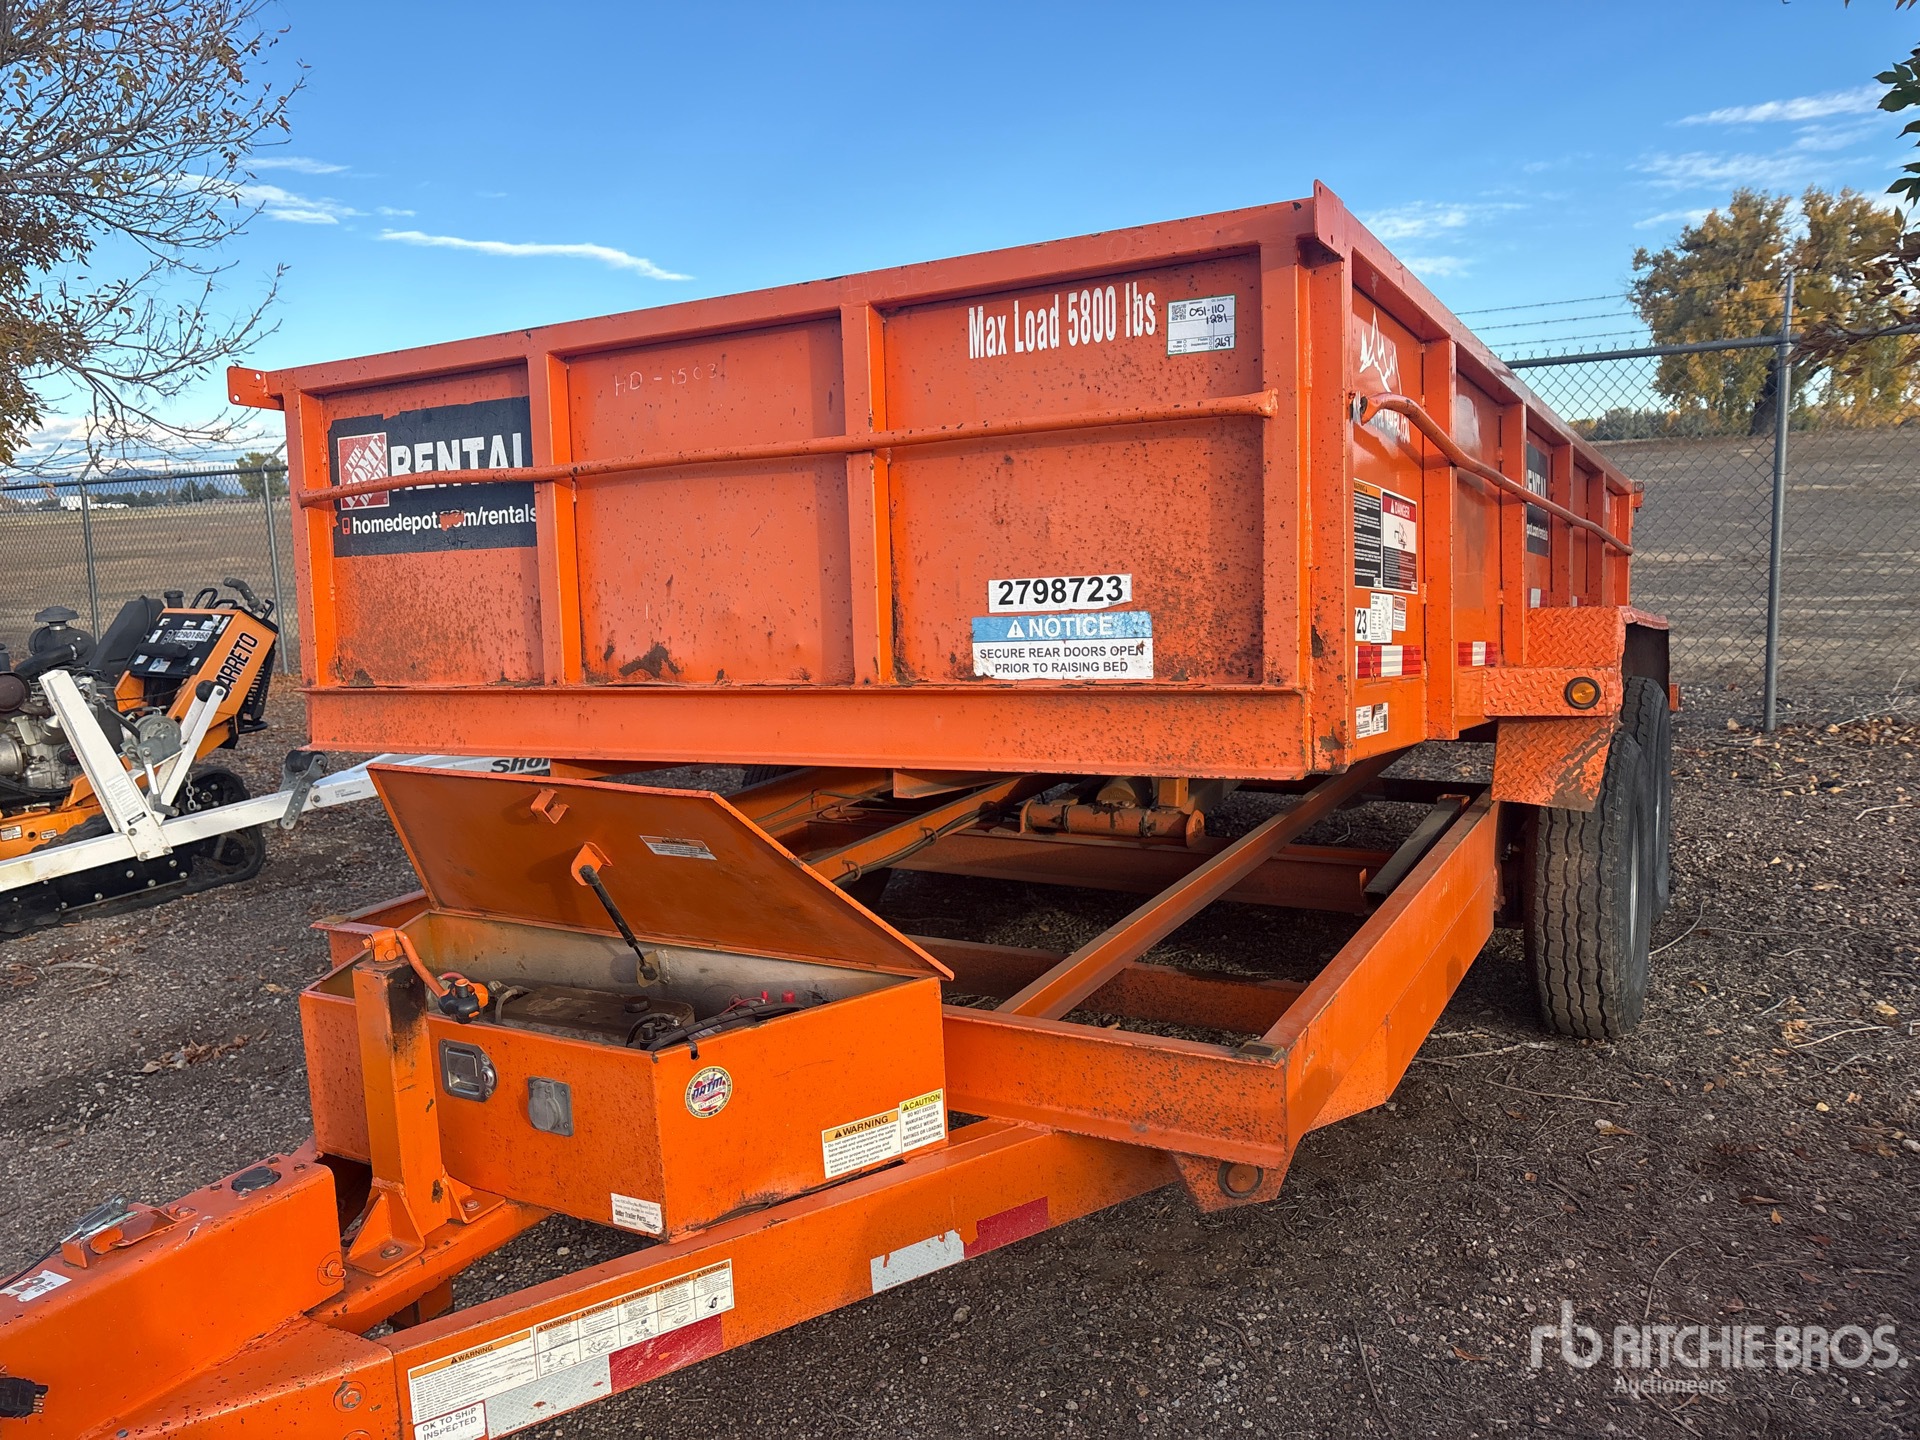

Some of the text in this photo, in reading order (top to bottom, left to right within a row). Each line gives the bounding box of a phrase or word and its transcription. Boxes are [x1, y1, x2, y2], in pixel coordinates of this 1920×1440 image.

[968, 281, 1156, 359] Max Load 5800 lbs
[1214, 336, 1230, 348] 269
[1394, 501, 1410, 519] DANGER
[998, 575, 1123, 606] 2798723
[1028, 615, 1114, 638] NOTICE
[979, 645, 1144, 660] SECURE REAR DOORS OPEN
[216, 632, 258, 692] ARRETO
[995, 661, 1128, 673] PRIOR TO RAISING BED
[909, 1093, 940, 1109] CAUTION
[842, 1116, 888, 1136] WARNING
[700, 1262, 727, 1276] WARNING
[664, 1274, 691, 1289] WARNING
[625, 1288, 653, 1301] WARNING
[586, 1302, 614, 1316] WARNING
[542, 1315, 573, 1330] WARNING
[458, 1344, 494, 1361] WARNING
[422, 1407, 476, 1432] OK TO SHIP
[424, 1416, 477, 1440] INSPECTED
